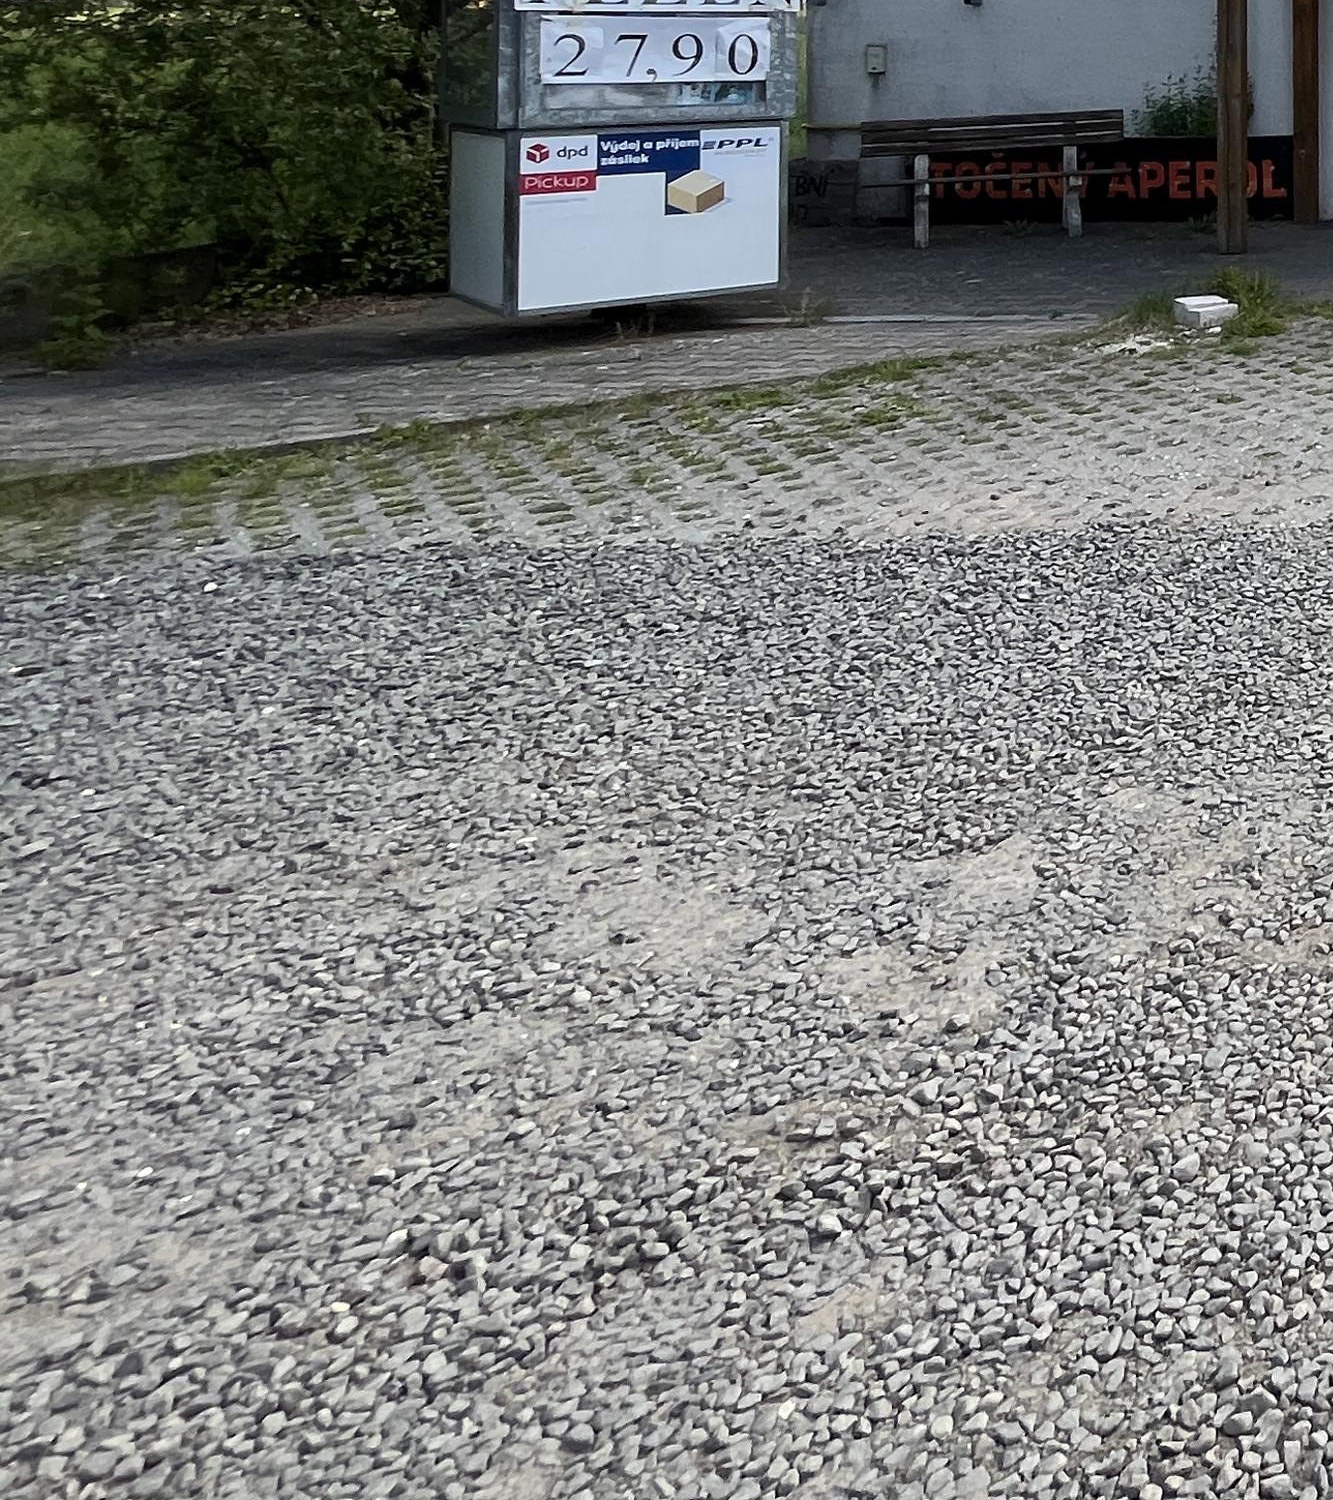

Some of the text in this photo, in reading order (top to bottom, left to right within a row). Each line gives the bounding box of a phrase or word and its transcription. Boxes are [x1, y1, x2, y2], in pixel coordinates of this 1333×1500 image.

[552, 32, 760, 82] 27,90
[600, 137, 641, 153] Výdej
[643, 143, 652, 151] a
[655, 137, 700, 152] příjem
[716, 137, 769, 150] PPL
[556, 145, 588, 160] dpd
[600, 153, 650, 167] zásilek
[524, 173, 590, 190] Pickup
